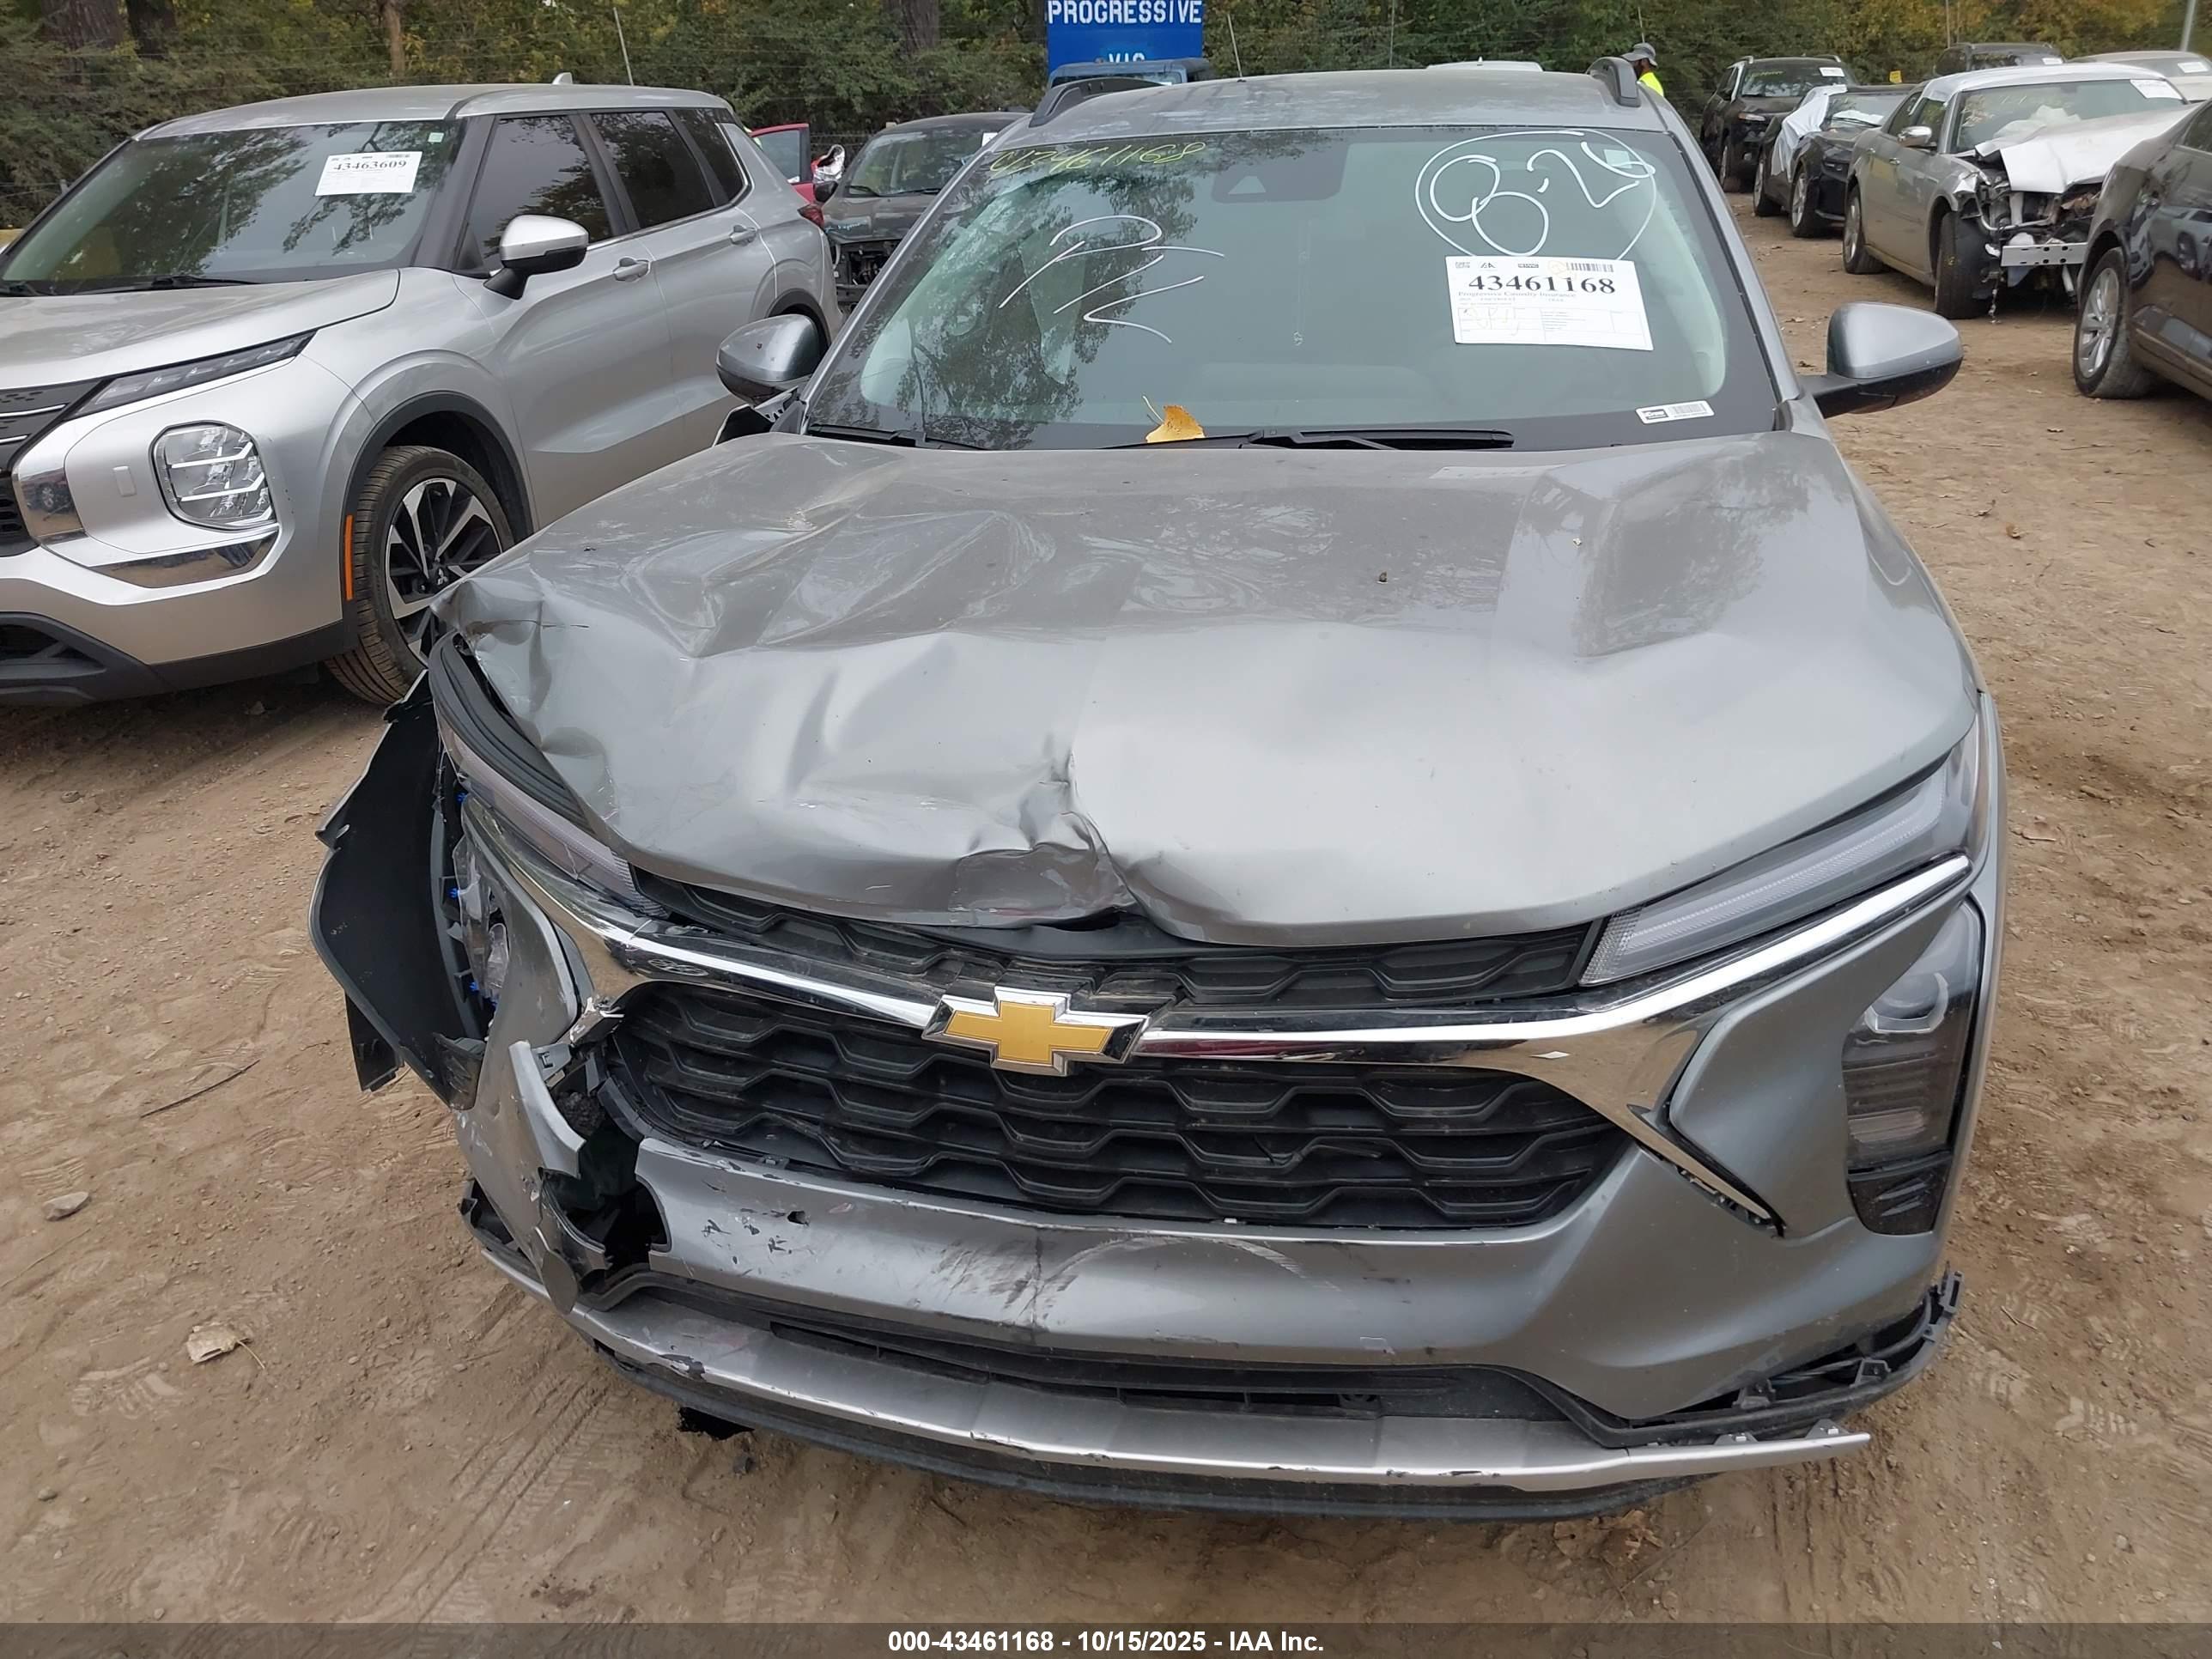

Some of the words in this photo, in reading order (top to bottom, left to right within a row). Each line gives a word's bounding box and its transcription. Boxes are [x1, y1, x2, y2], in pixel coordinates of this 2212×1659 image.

[1048, 0, 1202, 24] PROGRESSIVE
[333, 160, 407, 171] 43463609
[1468, 275, 1616, 295] 43461168
